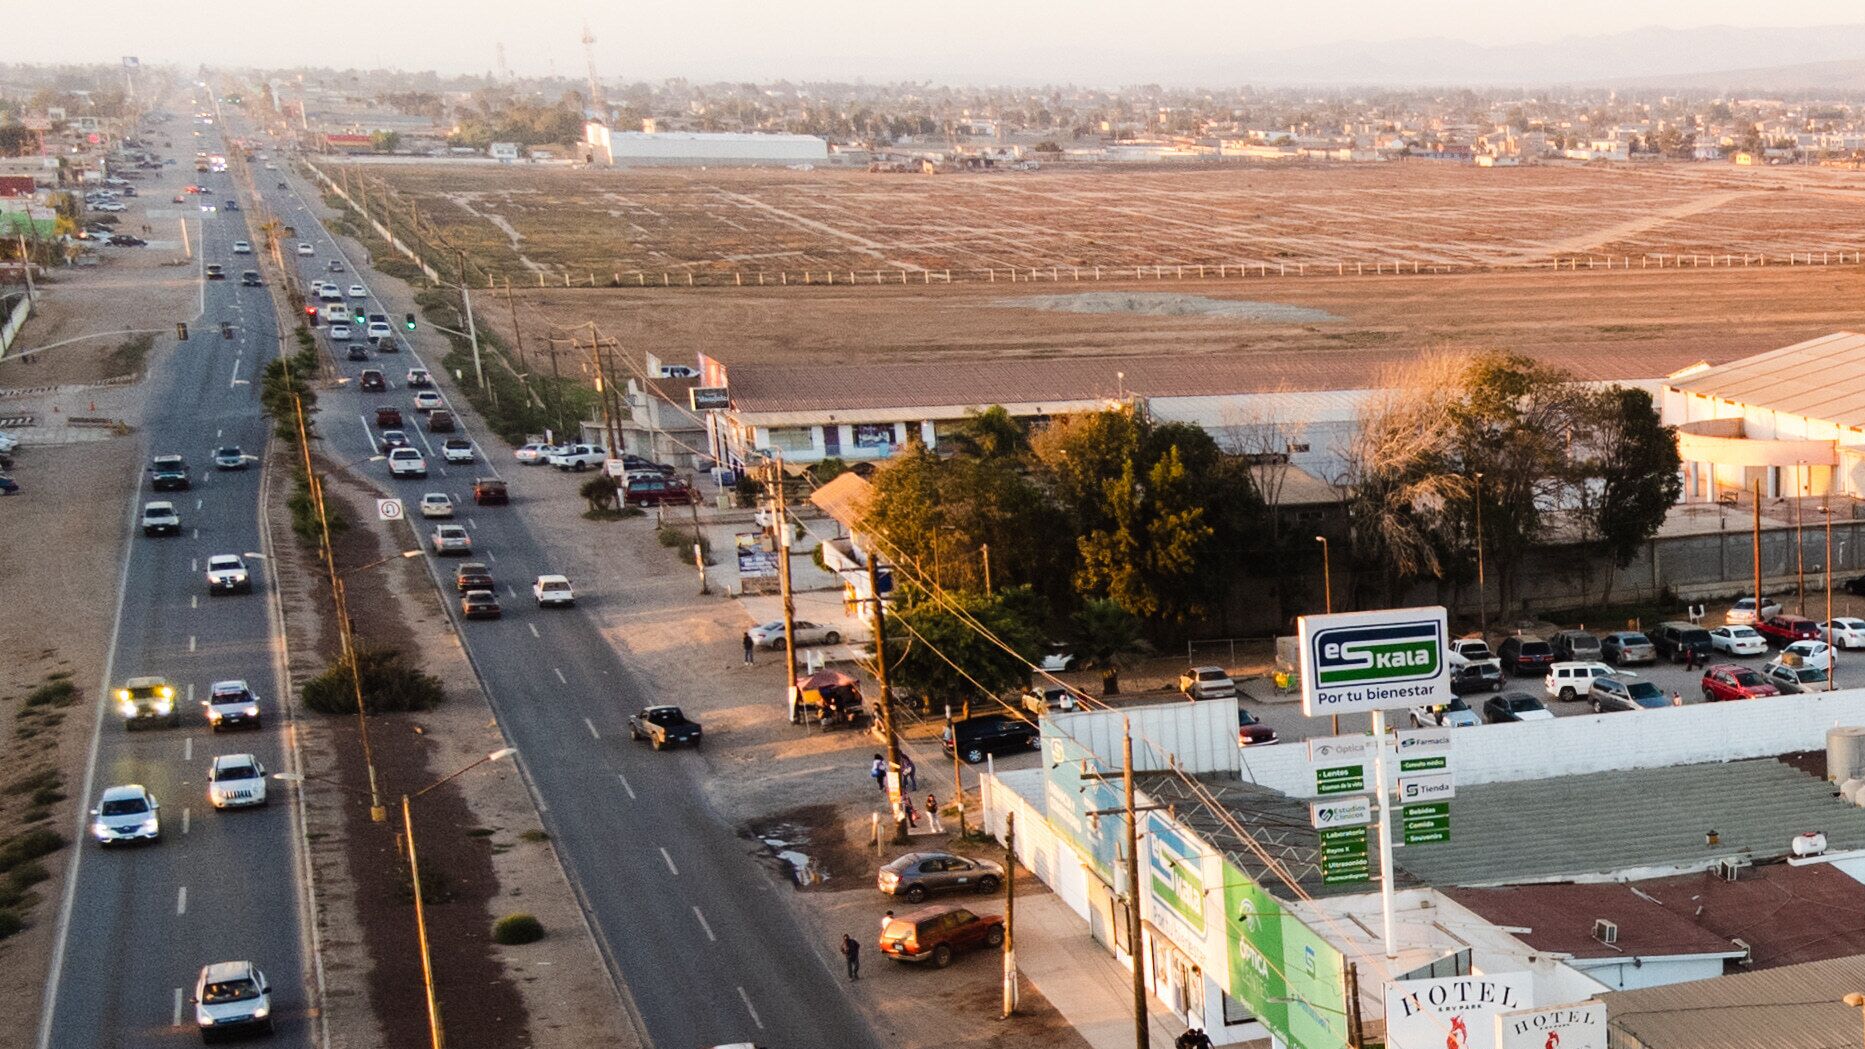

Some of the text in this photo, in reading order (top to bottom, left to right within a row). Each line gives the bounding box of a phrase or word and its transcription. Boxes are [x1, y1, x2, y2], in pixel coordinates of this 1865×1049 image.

[1318, 685, 1435, 705] Por tu bienestar
[1335, 744, 1364, 754] Óptica
[1322, 769, 1349, 778] Lentes
[1420, 784, 1450, 794] Tienda
[1333, 805, 1366, 814] Estudios
[1402, 981, 1517, 1017] HOTEL
[1514, 1011, 1595, 1035] HOTEL
